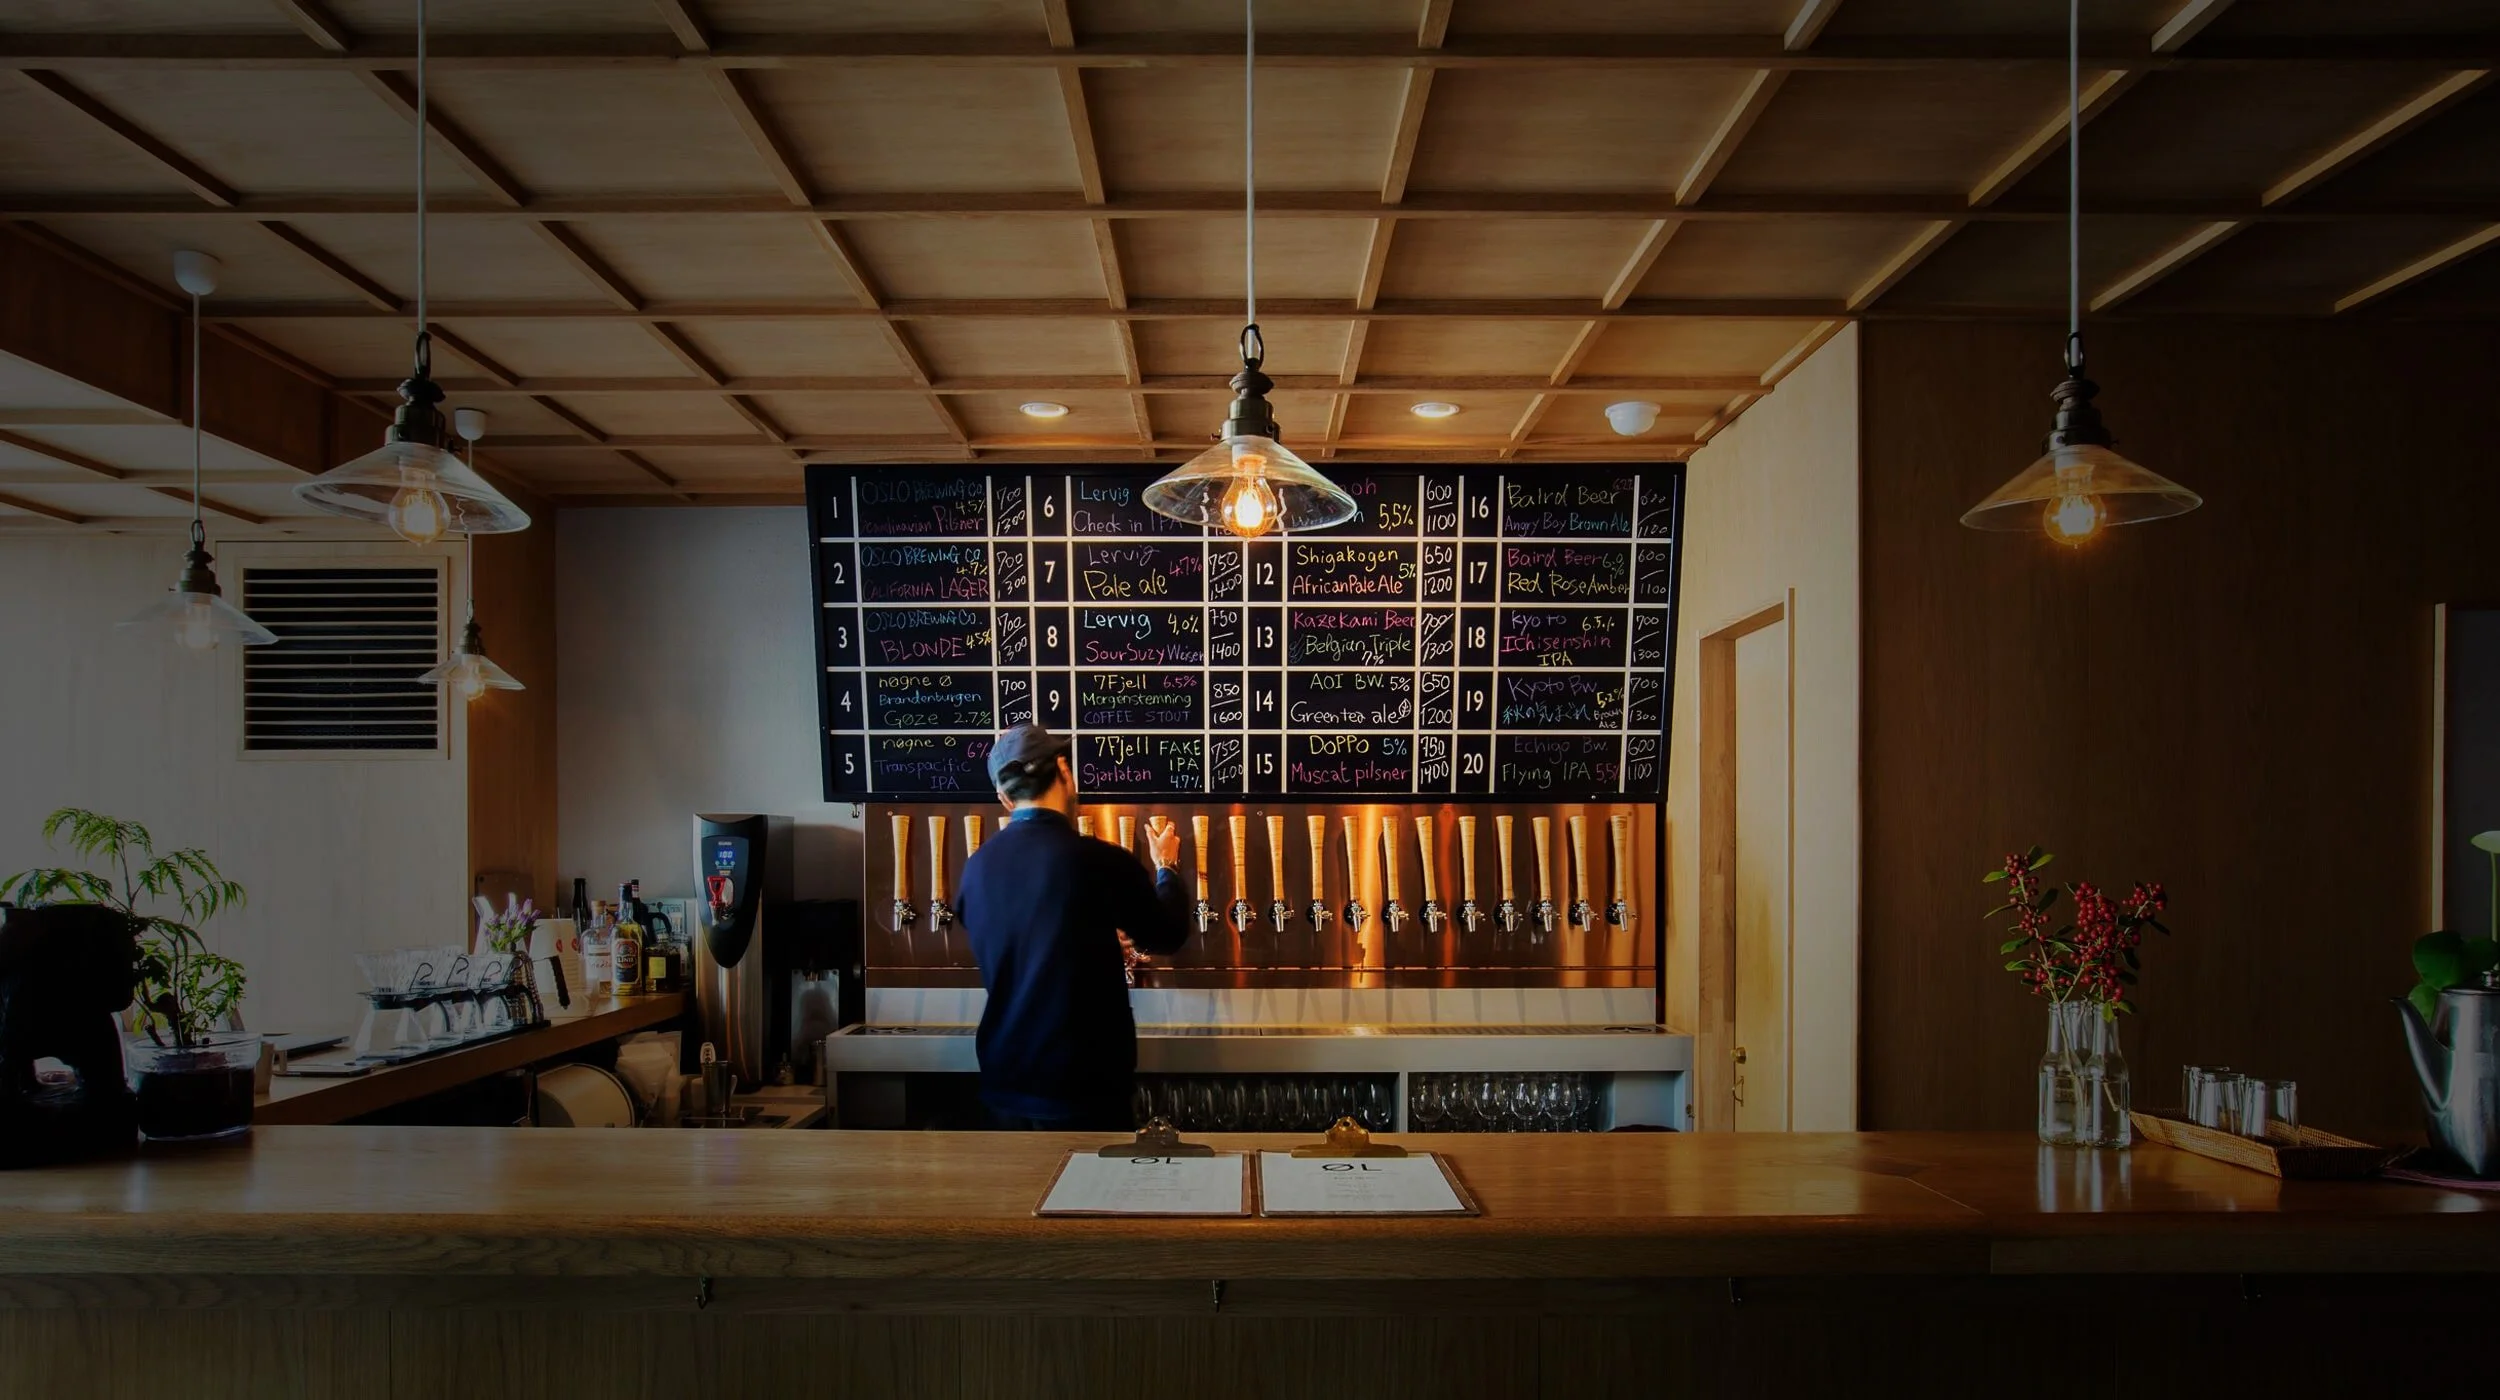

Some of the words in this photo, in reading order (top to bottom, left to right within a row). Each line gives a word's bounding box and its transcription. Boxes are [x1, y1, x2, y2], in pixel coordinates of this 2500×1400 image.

[996, 486, 1021, 510] 700
[1081, 480, 1130, 507] Lervig
[1427, 479, 1452, 501] 600
[1578, 485, 1620, 505] Beer
[833, 496, 838, 519] 1
[1043, 495, 1055, 518] 6
[1471, 496, 1489, 519] 16
[1073, 510, 1121, 532] Check
[1130, 519, 1143, 532] in
[1427, 513, 1456, 533] 1100
[1504, 515, 1540, 536] Angry
[1543, 511, 1566, 534] Boy
[1569, 512, 1609, 531] Brown
[861, 546, 901, 567] OSLO
[996, 550, 1023, 576] 700
[1088, 544, 1160, 567] Lervig
[1209, 551, 1238, 576] 750
[1296, 544, 1399, 574] Shigakogen
[1424, 546, 1453, 565] 650
[1507, 547, 1557, 568] Baird
[1564, 548, 1602, 566] Beer
[1638, 551, 1666, 563] 600
[833, 562, 845, 584] 2
[1044, 560, 1056, 584] 7
[1256, 562, 1274, 585] 12
[1470, 561, 1488, 584] 17
[1507, 571, 1543, 594] Red
[939, 576, 989, 600] LAGER
[1083, 570, 1131, 600] Pale
[1138, 568, 1168, 595] ale
[1424, 575, 1453, 596] 1200
[865, 612, 907, 633] OSLO
[997, 612, 1021, 636] 700
[1083, 609, 1152, 640] Lervig
[1209, 609, 1238, 627] 750
[1383, 609, 1415, 631] Beer
[1636, 614, 1659, 631] 700
[838, 626, 848, 649] 3
[1047, 625, 1058, 648] 8
[1256, 626, 1274, 649] 13
[1304, 633, 1365, 662] Belgian
[1369, 633, 1413, 658] Triple
[1468, 626, 1486, 649] 18
[880, 636, 966, 663] BLONDE
[1211, 642, 1240, 661] 1400
[1537, 650, 1574, 667] IPA
[1632, 649, 1661, 663] 1300
[1000, 679, 1026, 695] 700
[1163, 675, 1199, 689] 6.5%
[1213, 683, 1240, 699] 850
[1309, 673, 1344, 690] AOI
[1390, 676, 1411, 692] 5%
[1422, 672, 1450, 693] 650
[1506, 677, 1565, 701] Kyoto
[1630, 678, 1659, 695] 700
[840, 690, 851, 713] 4
[1049, 689, 1060, 712] 9
[1255, 690, 1274, 712] 14
[1466, 690, 1484, 712] 19
[953, 710, 992, 727] 2.7%
[1004, 710, 1032, 726] 1300
[1084, 710, 1134, 725] COFFEE
[1145, 710, 1191, 723] STOUT
[1213, 711, 1242, 724] 1600
[1372, 703, 1399, 724] ale
[1420, 706, 1453, 726] 1200
[1630, 710, 1656, 723] 1300
[1159, 739, 1201, 756] FAKE
[1211, 739, 1240, 764] 750
[1382, 738, 1408, 756] 5%
[1514, 736, 1571, 765] Echigo
[1628, 737, 1655, 756] 600
[844, 753, 854, 775] 5
[874, 758, 972, 780] Transpacific
[1169, 758, 1199, 771] IPA
[1256, 753, 1273, 775] 15
[1291, 761, 1351, 784] Muscat
[1355, 760, 1410, 788] pilsner
[1463, 753, 1484, 775] 20
[1502, 762, 1552, 789] Flying
[1563, 761, 1591, 781] IPA
[930, 775, 960, 790] IPA
[1211, 764, 1243, 790] 1400
[1322, 1163, 1382, 1172] ØL
